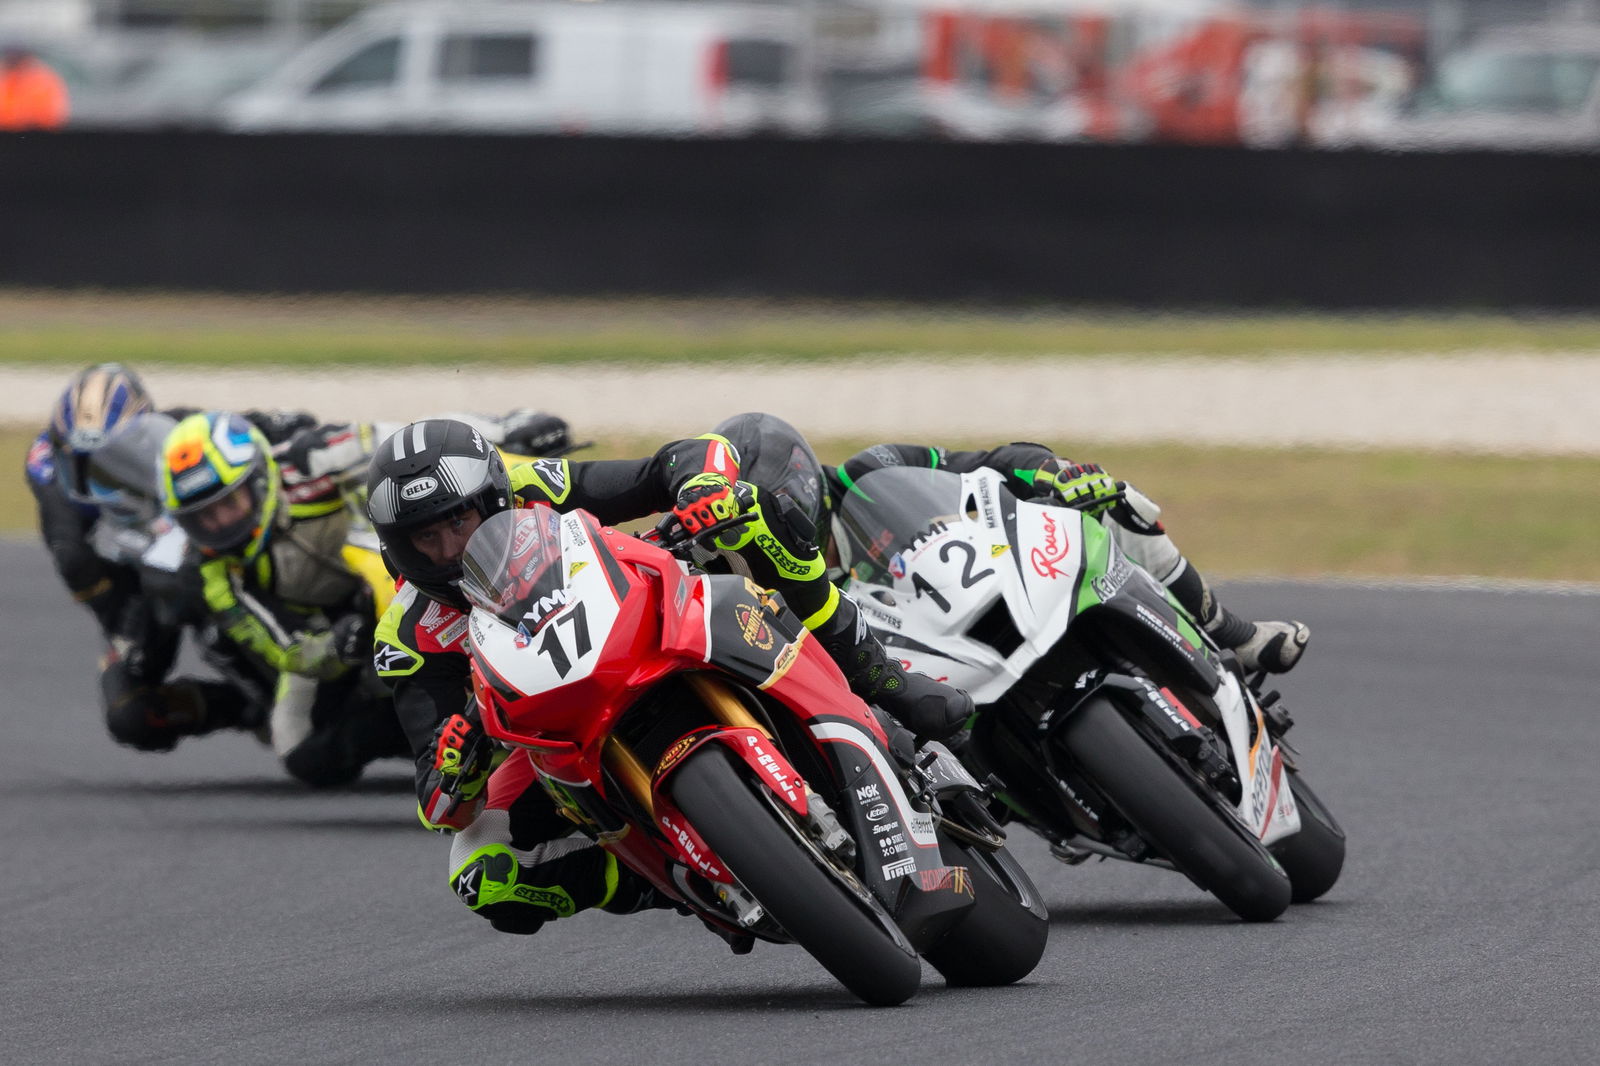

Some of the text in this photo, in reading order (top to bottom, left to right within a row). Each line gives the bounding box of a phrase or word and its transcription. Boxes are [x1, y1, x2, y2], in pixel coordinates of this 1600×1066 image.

[406, 481, 433, 497] BELL
[911, 539, 996, 614] 12
[425, 611, 457, 634] HONDA
[536, 599, 593, 680] 17
[743, 605, 765, 648] PENRITE
[746, 735, 798, 802] PIRELLI
[856, 783, 880, 801] NGK
[662, 816, 720, 876] PIRELLI
[881, 856, 917, 881] PIRELLI
